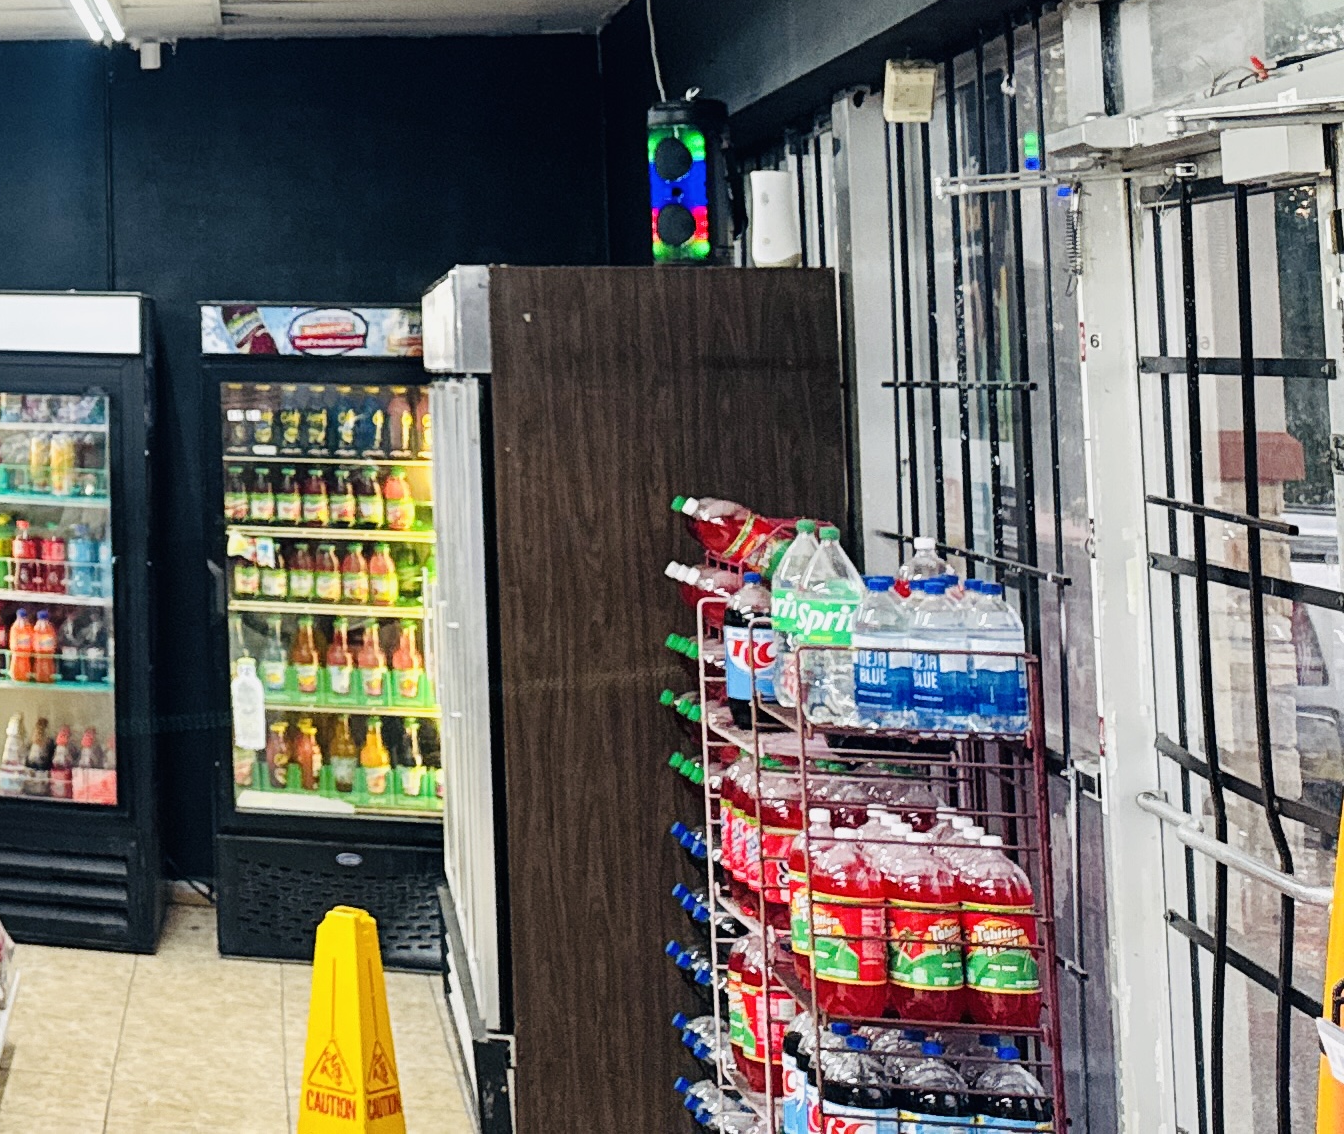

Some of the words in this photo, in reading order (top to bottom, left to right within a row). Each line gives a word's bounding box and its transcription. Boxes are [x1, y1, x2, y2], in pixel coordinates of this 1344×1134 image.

[1090, 334, 1100, 348] 6
[797, 604, 853, 638] Sprit
[859, 667, 888, 686] BLUE
[973, 925, 1025, 943] Tahitian
[306, 1089, 356, 1121] CAUTION
